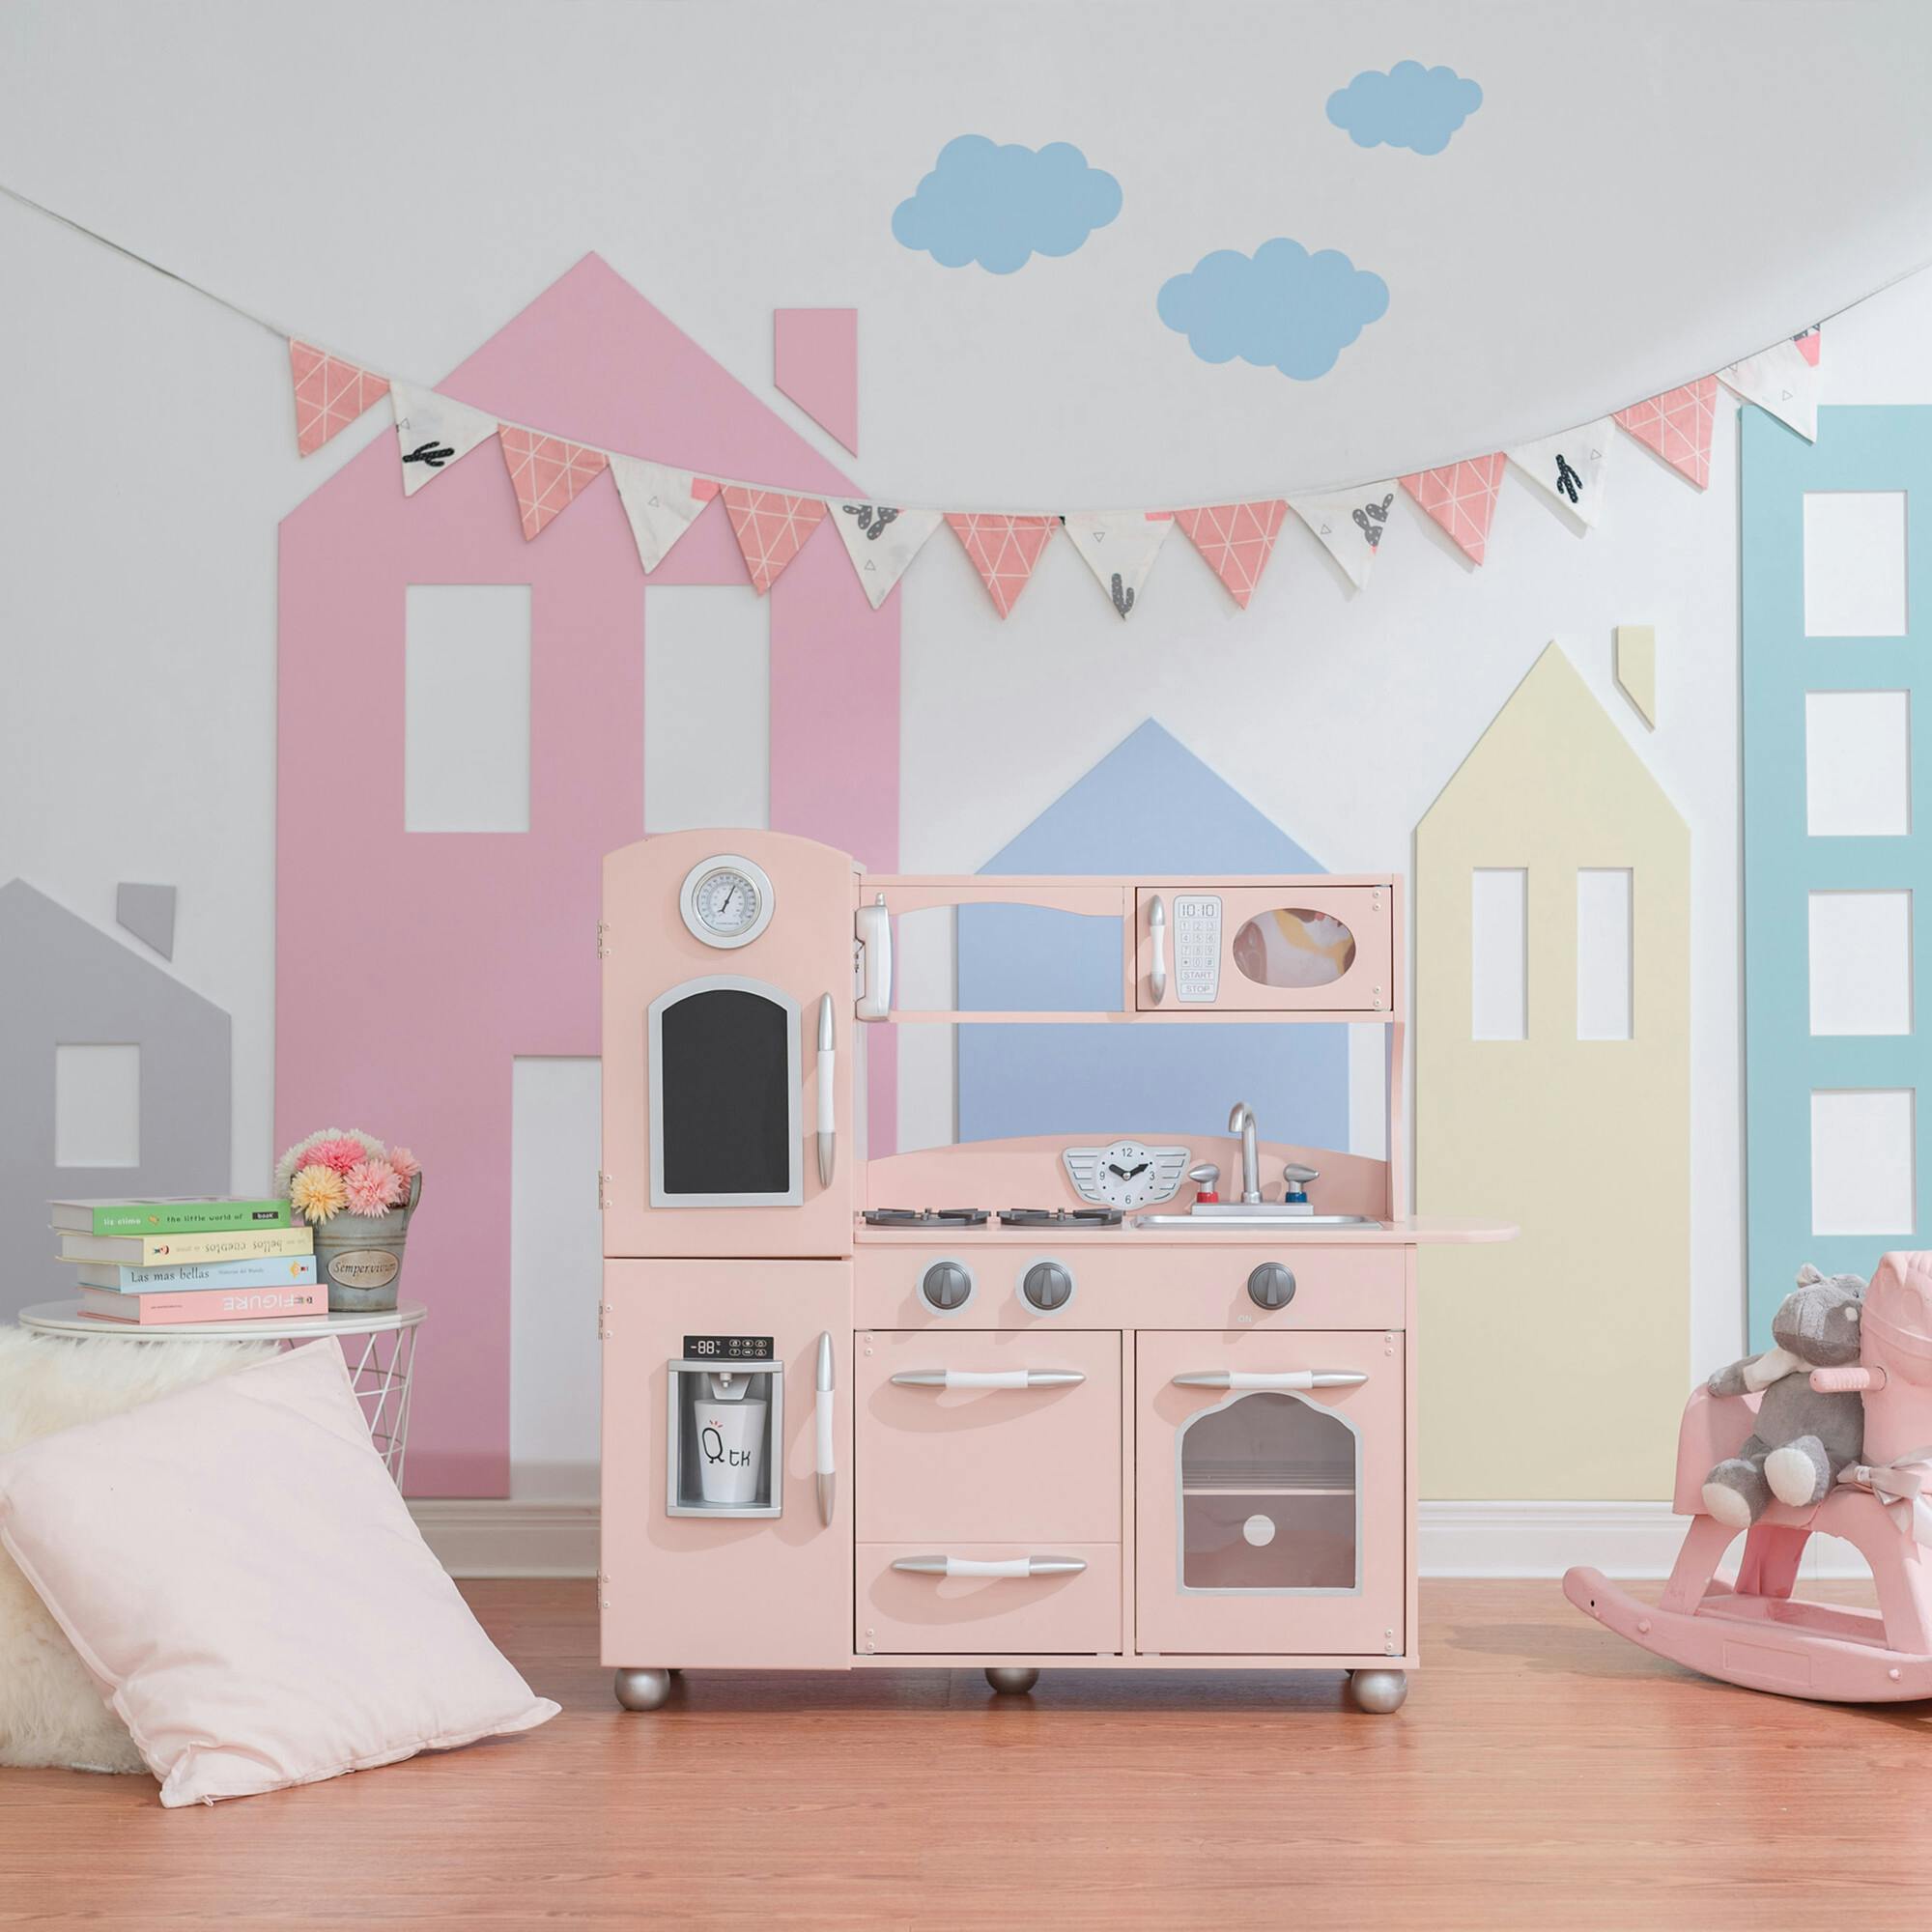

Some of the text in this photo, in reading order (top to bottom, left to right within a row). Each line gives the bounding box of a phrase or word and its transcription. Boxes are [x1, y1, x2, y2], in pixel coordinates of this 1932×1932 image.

[1183, 971, 1211, 980] START
[1186, 984, 1210, 993] STOP
[1122, 1148, 1133, 1157] 12
[1099, 1171, 1106, 1180] 9
[1150, 1171, 1155, 1180] 3
[1124, 1195, 1131, 1204] 6
[184, 1214, 206, 1223] little
[234, 1212, 243, 1221] of
[253, 1239, 283, 1252] bellos
[130, 1271, 149, 1283] Las
[154, 1271, 176, 1282] mas
[180, 1266, 210, 1280] bellas
[223, 1294, 295, 1312] FIGURE
